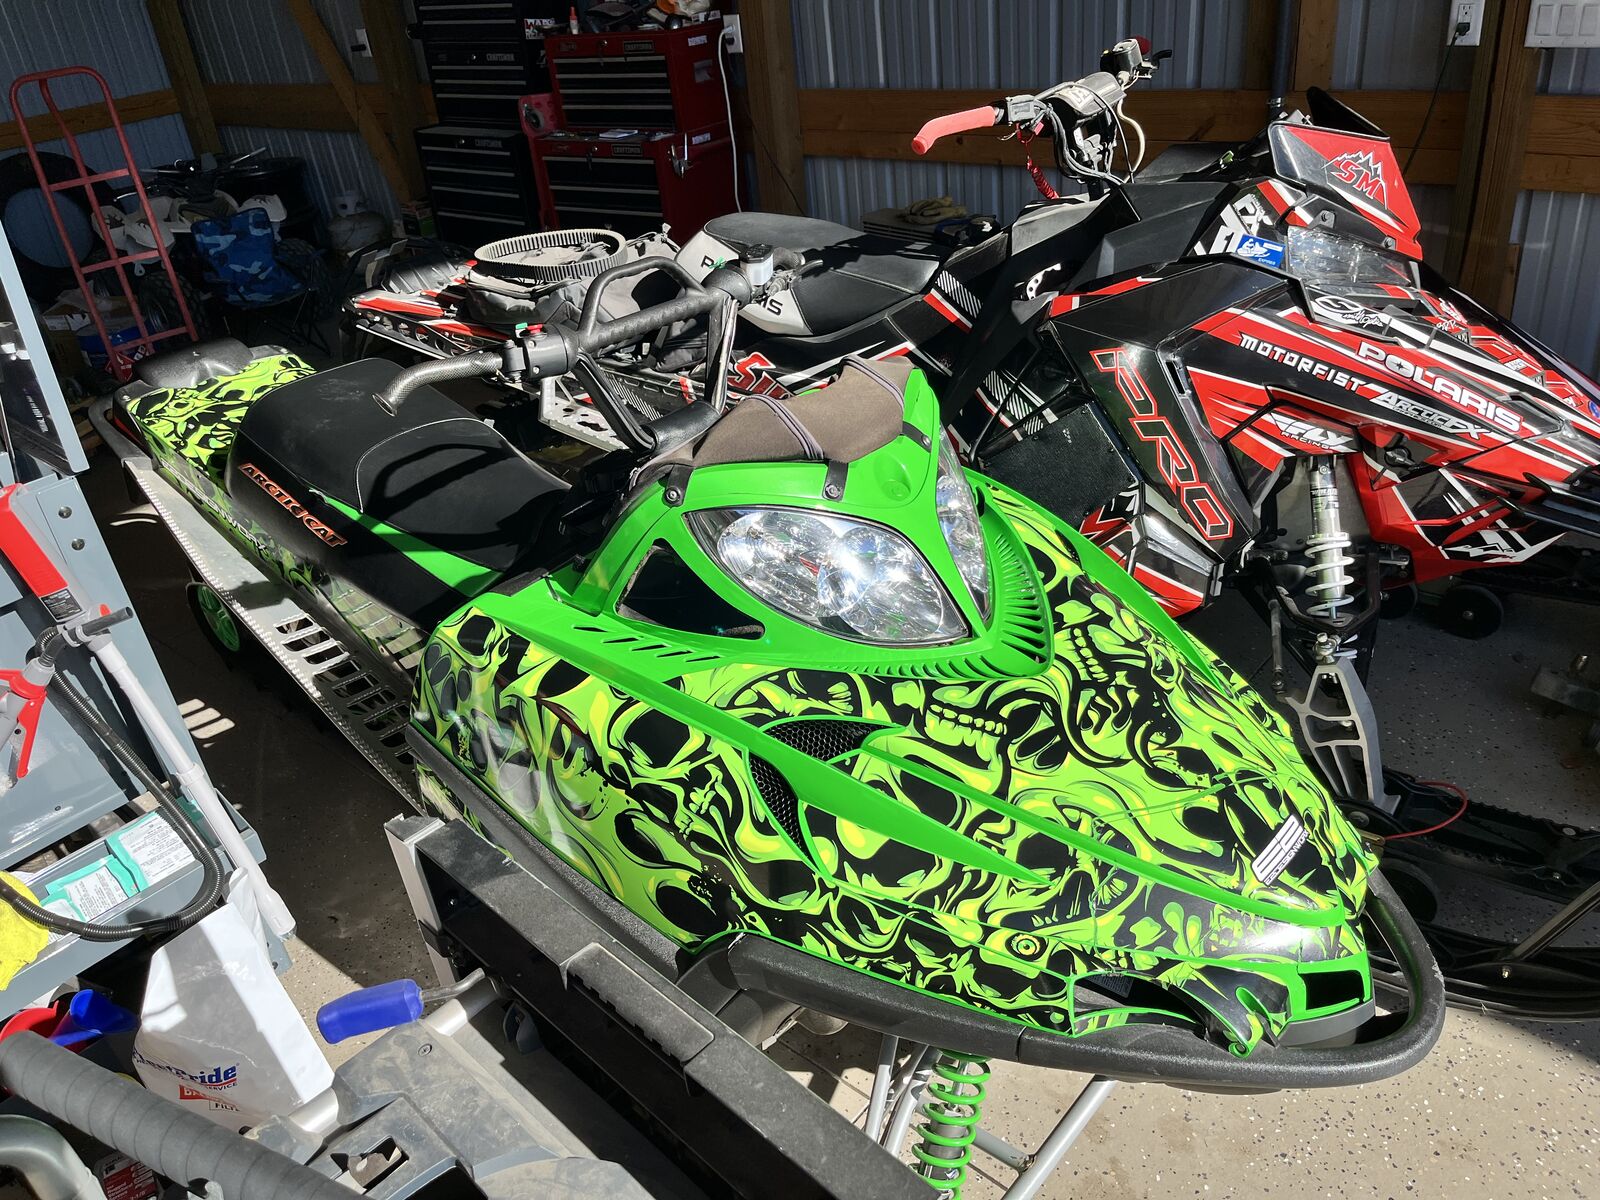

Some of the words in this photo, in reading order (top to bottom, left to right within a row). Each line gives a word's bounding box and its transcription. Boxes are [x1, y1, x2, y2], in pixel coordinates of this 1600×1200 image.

[1330, 160, 1381, 199] SM
[1239, 332, 1367, 392] MOTORFIST
[1357, 341, 1522, 433] POLARIS
[1089, 347, 1234, 541] PRO
[1278, 416, 1354, 446] FLY
[1281, 432, 1331, 450] RACING
[238, 463, 305, 519] ARCTIC
[302, 513, 349, 548] CAT
